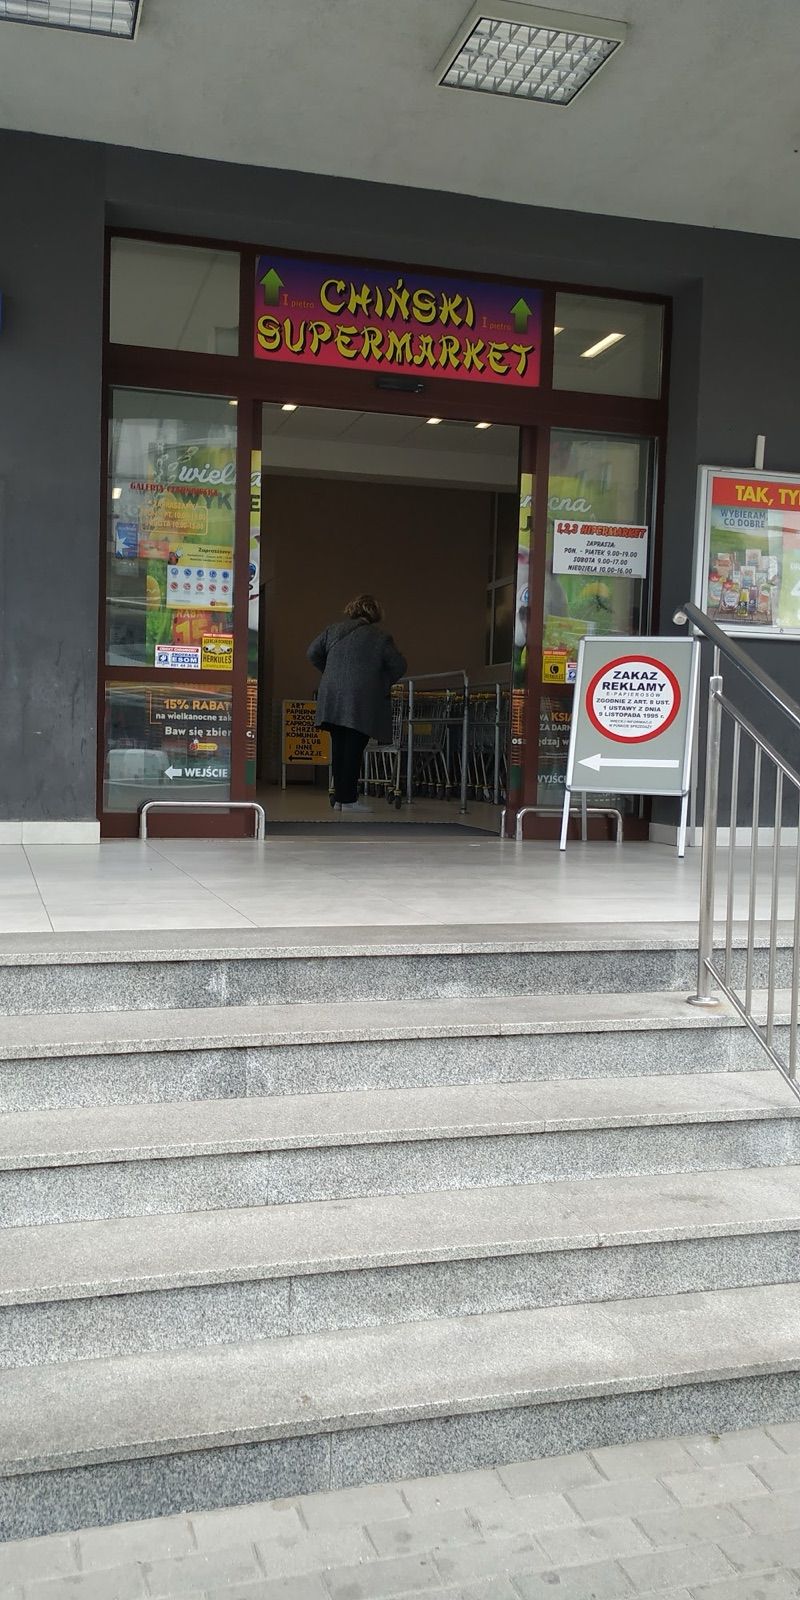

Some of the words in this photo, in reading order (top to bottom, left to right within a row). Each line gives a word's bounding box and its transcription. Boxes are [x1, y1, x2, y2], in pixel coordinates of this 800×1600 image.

[319, 278, 475, 329] CHIŃSKI
[256, 315, 533, 376] SUPERMARKET
[735, 485, 774, 506] TAK,
[779, 488, 800, 506] TY
[724, 518, 735, 527] CO
[738, 519, 765, 528] DOBRE
[580, 525, 647, 539] HIPERMARKET
[607, 550, 638, 558] 9.00-19.00
[573, 556, 595, 564] SOBOTA
[598, 558, 628, 566] 9.00-17.00
[568, 565, 597, 573] NIEDZIELA
[600, 567, 633, 575] 10.00-16.00
[203, 653, 232, 664] HERKULES
[613, 671, 658, 680] ZAKAZ
[602, 681, 666, 692] REKLAMY
[163, 699, 189, 710] 15%
[167, 712, 217, 721] wielkanocne
[165, 726, 186, 736] Baw
[189, 727, 203, 738] się
[540, 723, 550, 731] ZA
[184, 765, 228, 778] WEJŚCIE
